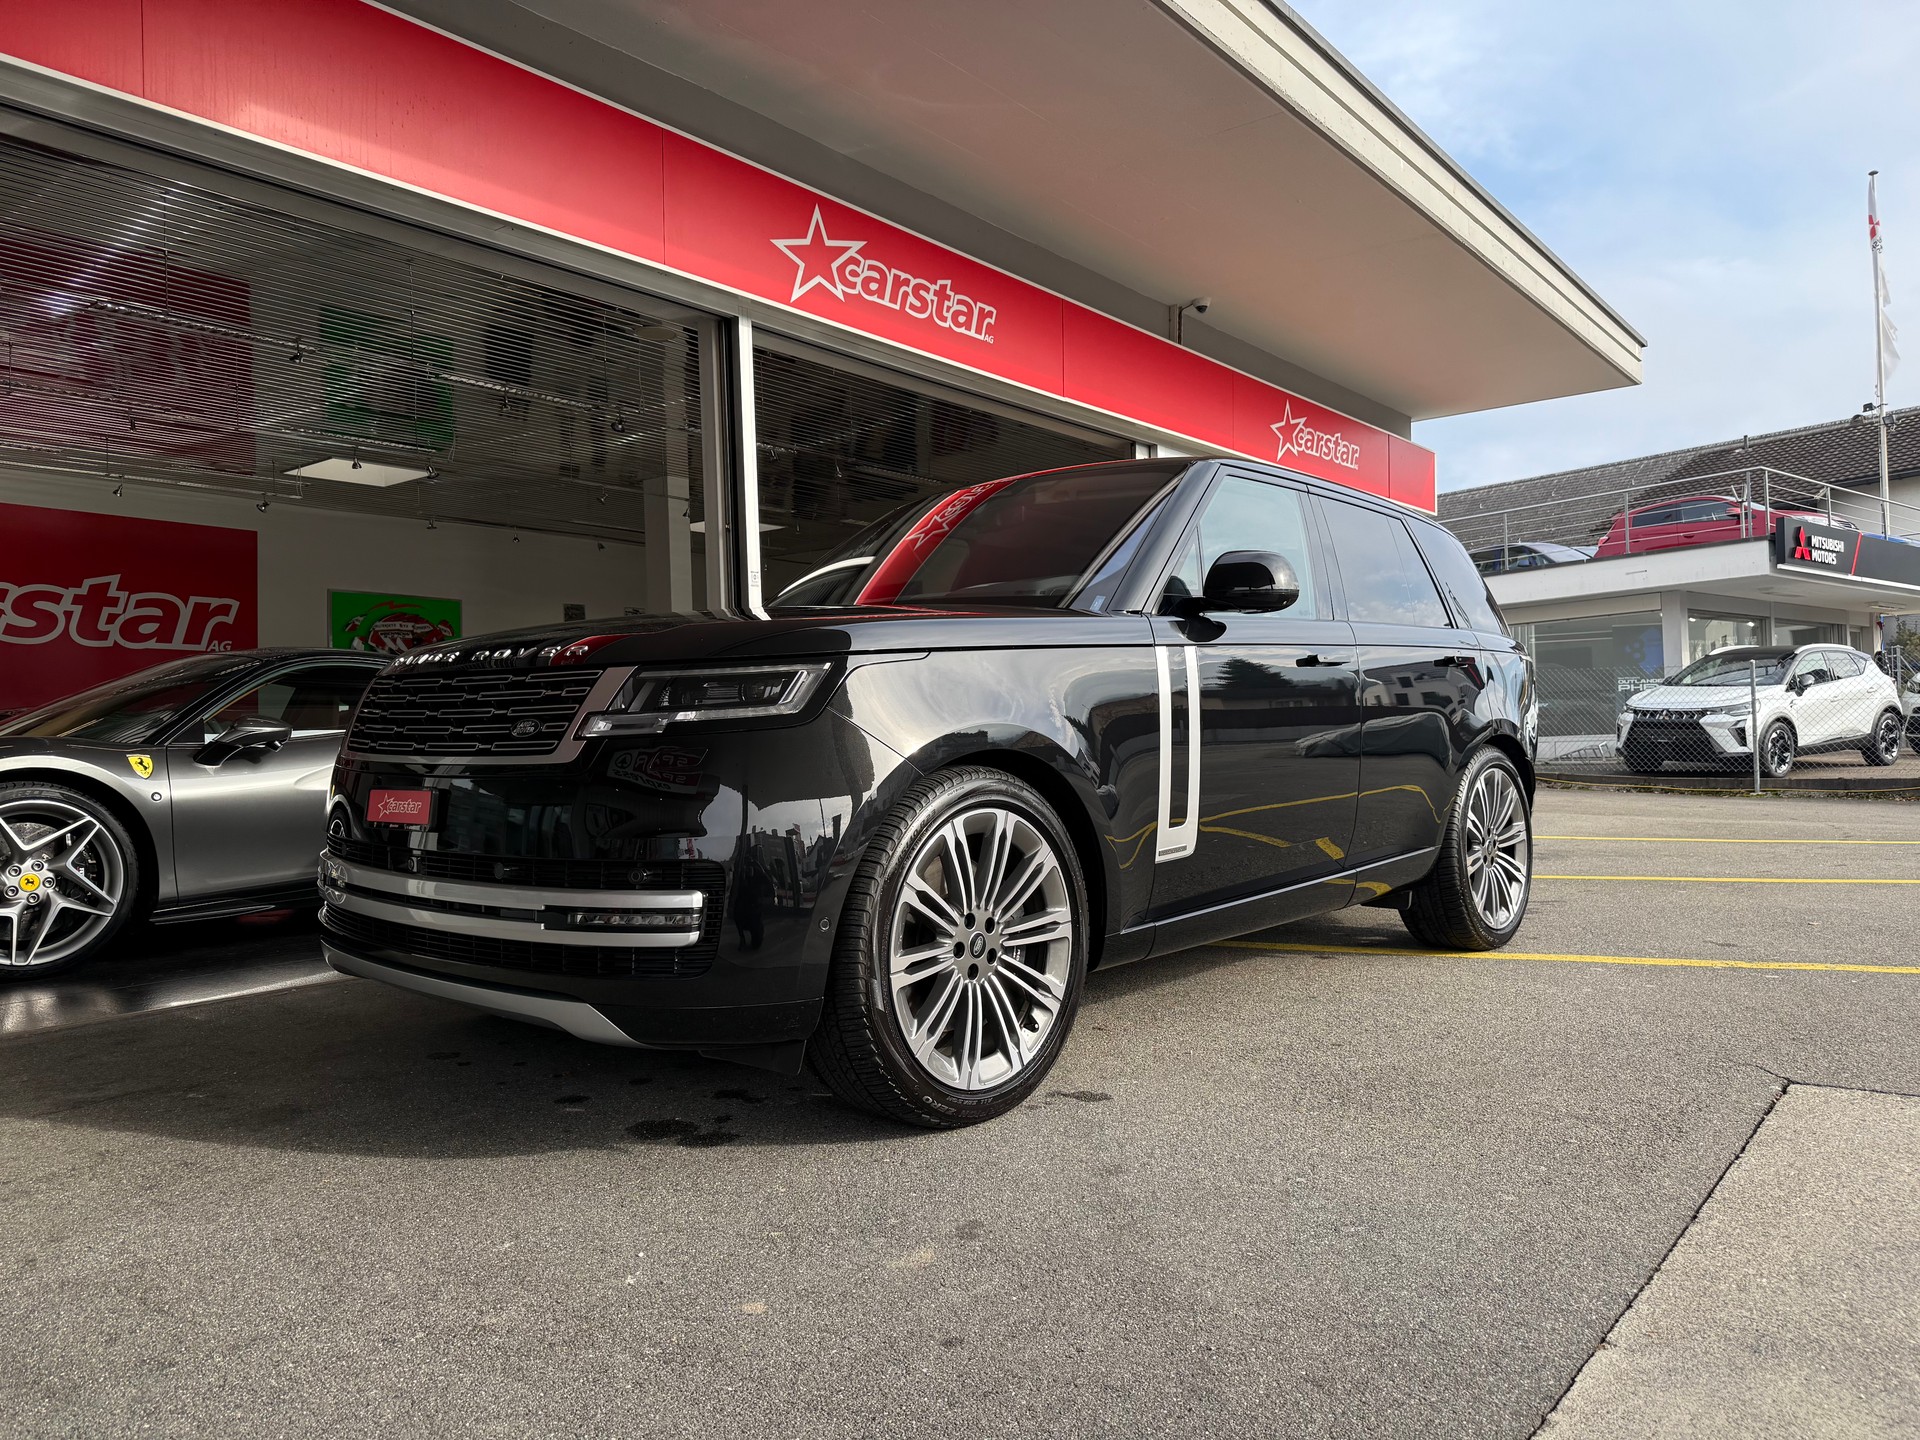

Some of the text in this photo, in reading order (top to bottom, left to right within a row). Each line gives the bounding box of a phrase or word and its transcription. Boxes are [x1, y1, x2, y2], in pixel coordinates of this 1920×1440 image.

[838, 252, 997, 344] carstar AG
[1294, 426, 1360, 468] carstar
[1811, 535, 1845, 552] MITSUBISHI
[1811, 549, 1837, 565] MOTORS
[206, 640, 232, 652] AG
[387, 799, 422, 814] carstar
[922, 1095, 957, 1115] ZERO
